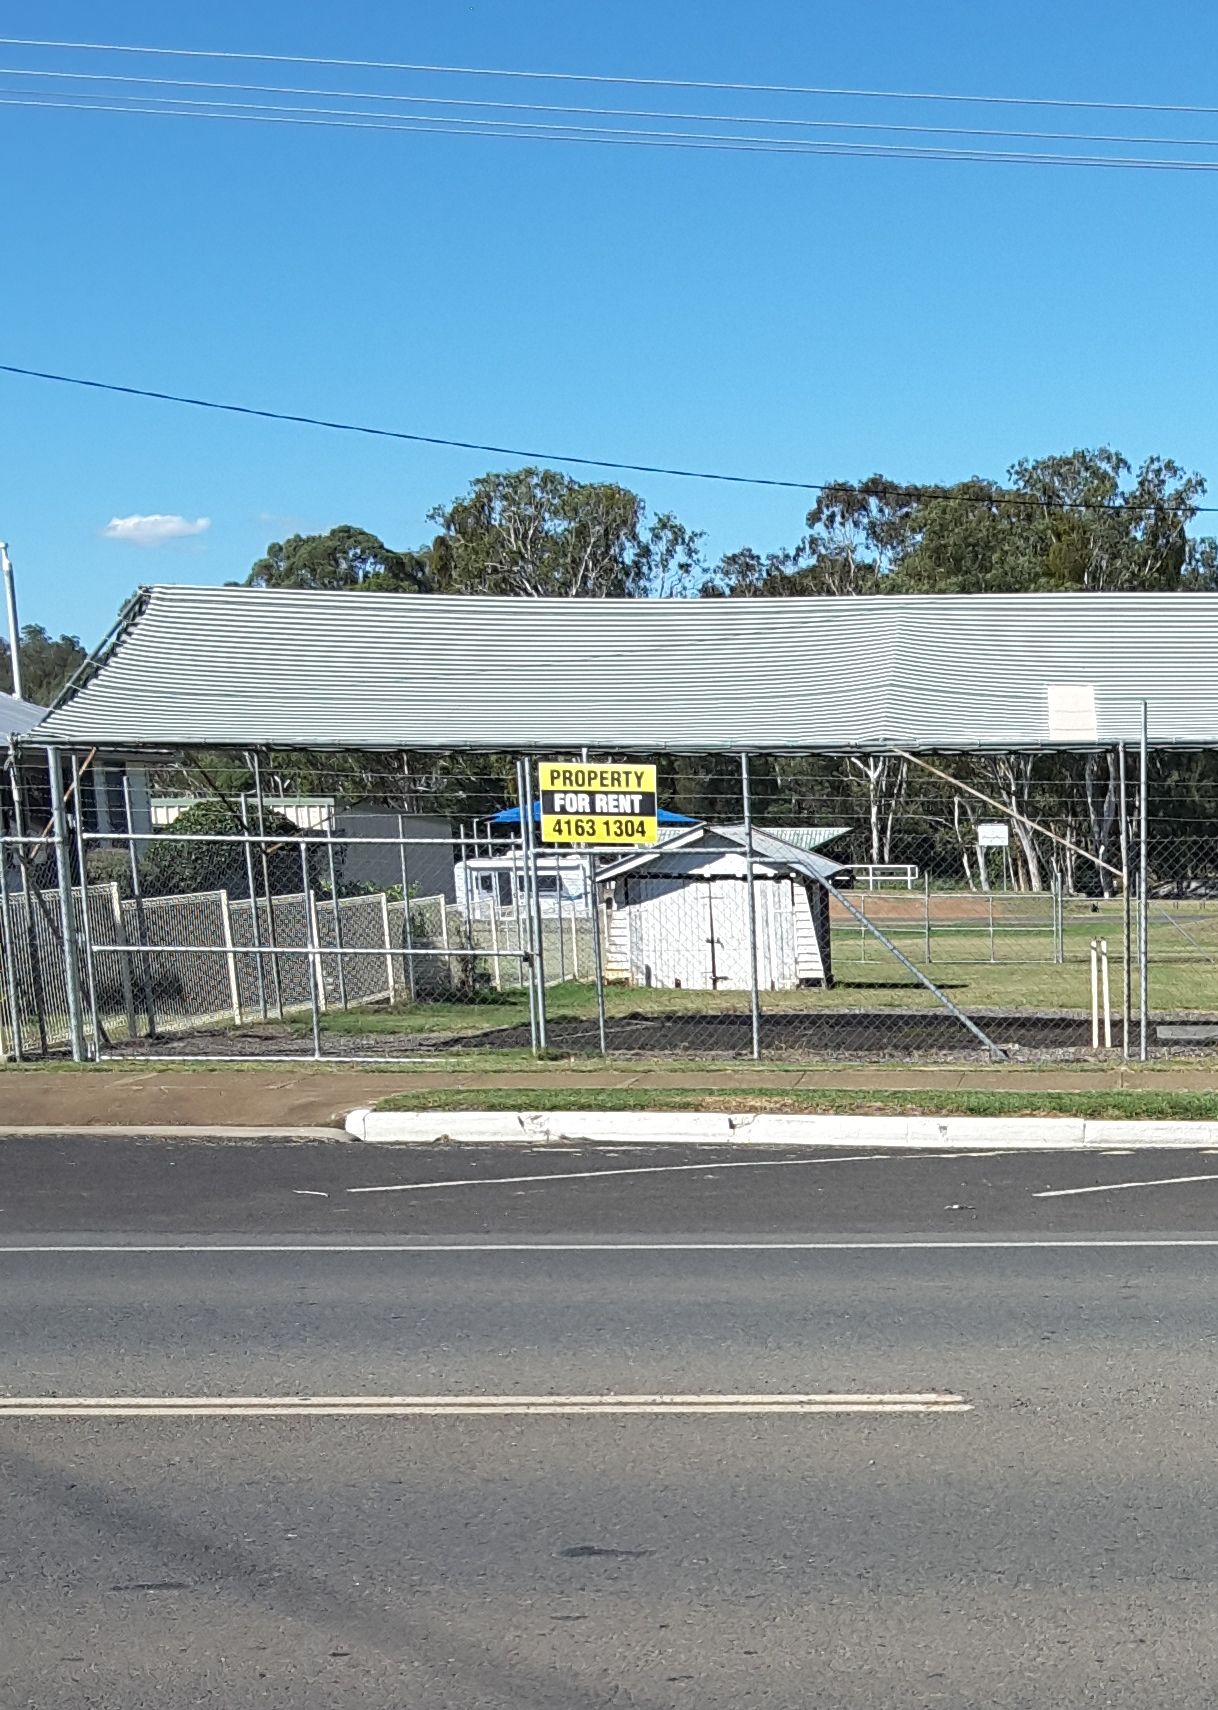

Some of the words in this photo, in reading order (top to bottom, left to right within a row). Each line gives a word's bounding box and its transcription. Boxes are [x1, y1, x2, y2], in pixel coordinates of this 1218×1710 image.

[550, 769, 645, 788] PROPERTY
[554, 793, 590, 813] FOR
[595, 794, 643, 813] RENT
[552, 819, 596, 837] 4163
[603, 820, 646, 837] 1304
